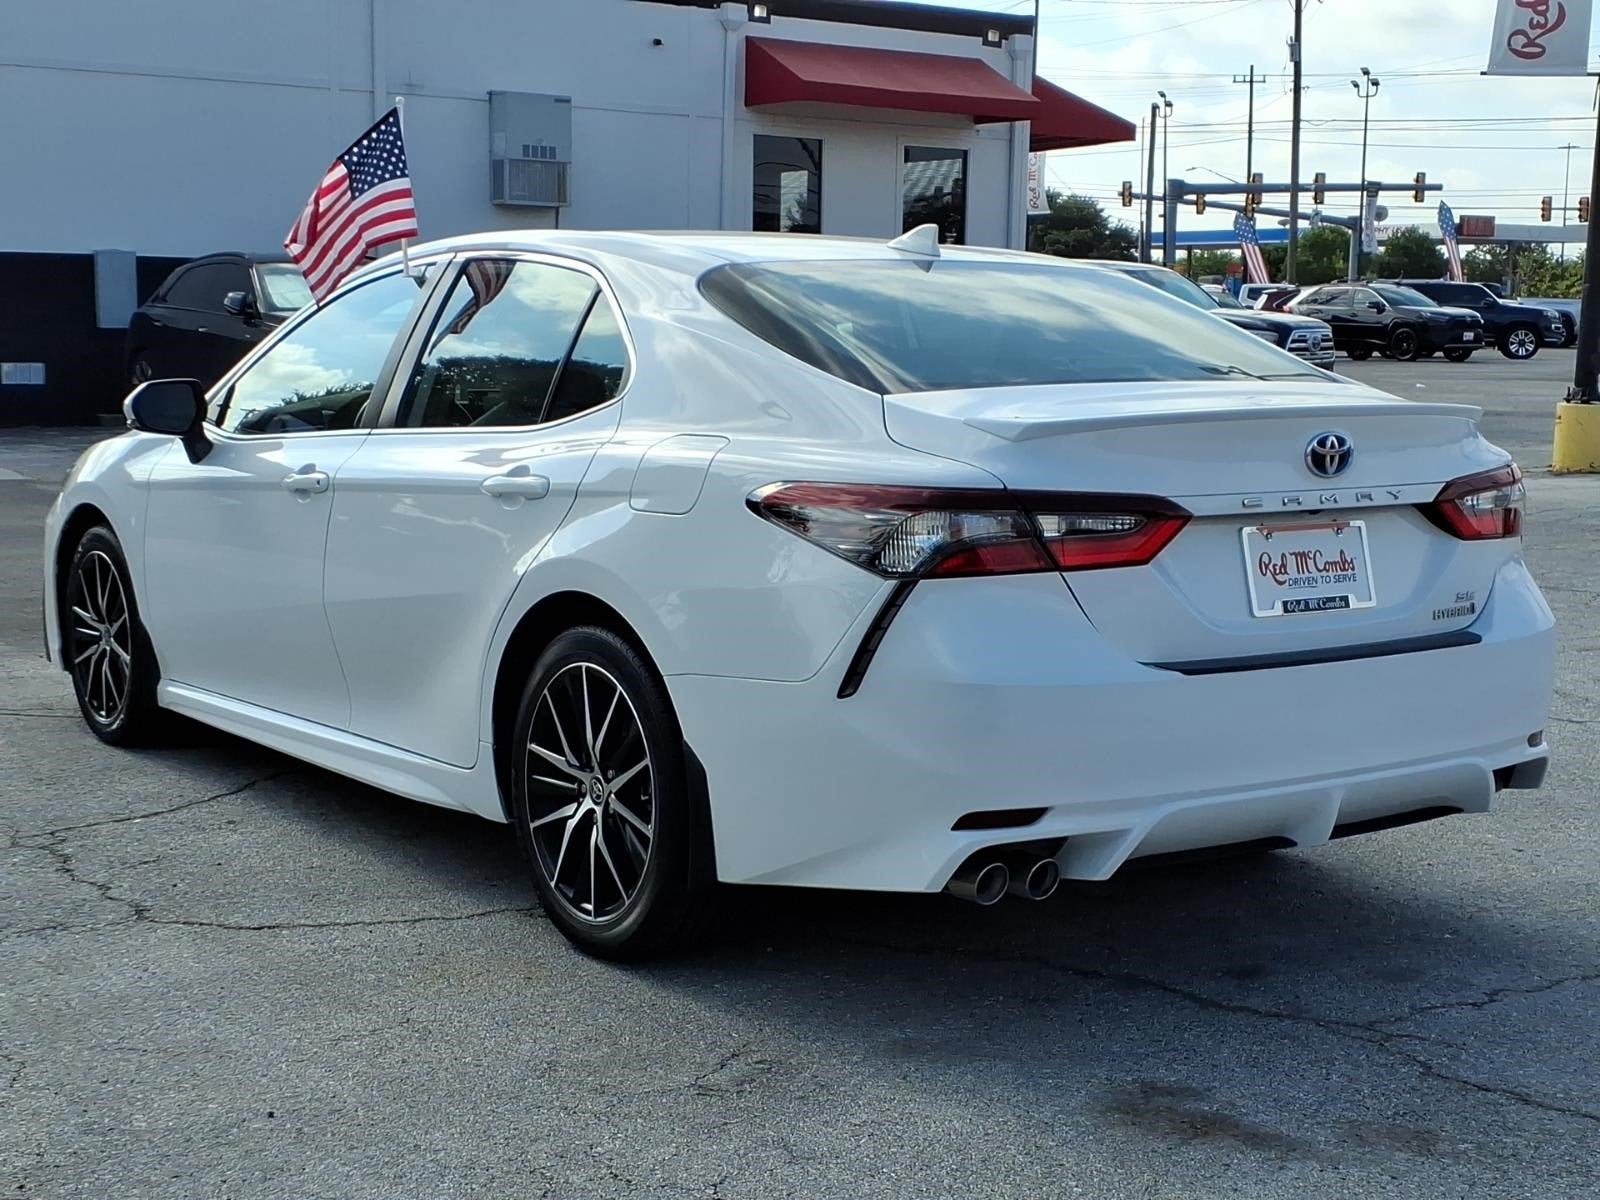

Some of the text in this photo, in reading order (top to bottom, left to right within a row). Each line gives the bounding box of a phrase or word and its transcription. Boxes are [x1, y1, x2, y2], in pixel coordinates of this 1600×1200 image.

[1242, 490, 1402, 508] CAMRY
[1258, 548, 1356, 586] Red McCombs
[1288, 572, 1357, 587] DRIVEN TO SERVE
[1287, 597, 1346, 612] Red McCombs
[1432, 602, 1475, 620] HYBRID
